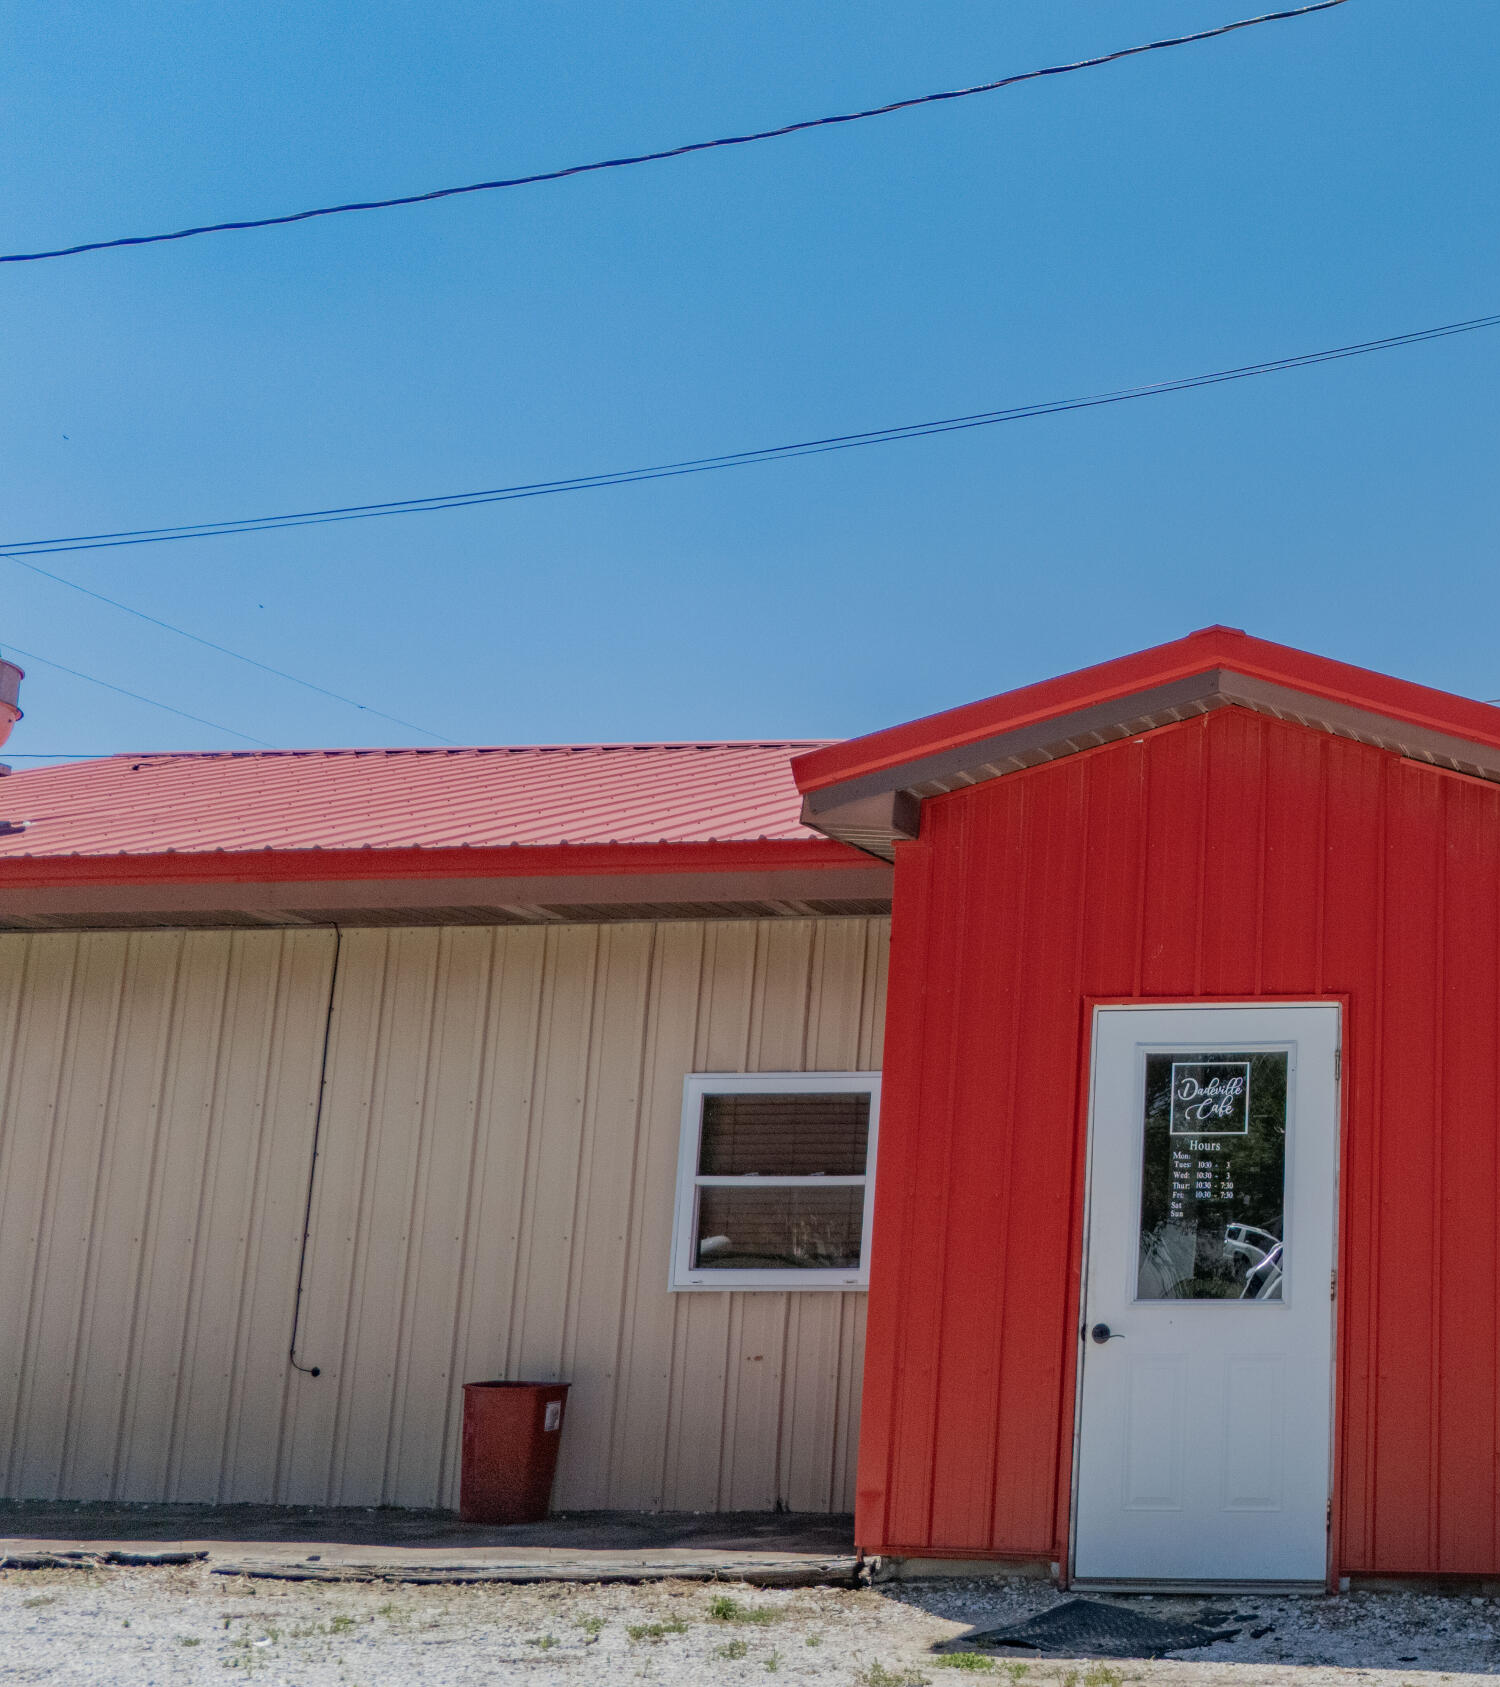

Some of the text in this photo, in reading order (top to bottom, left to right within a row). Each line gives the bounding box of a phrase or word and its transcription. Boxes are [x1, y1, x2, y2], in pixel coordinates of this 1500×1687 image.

[1178, 1077, 1243, 1100] Dadeville
[1185, 1095, 1234, 1119] Cafe
[1190, 1140, 1221, 1151] Hours
[1173, 1152, 1191, 1160] Mon:
[1226, 1161, 1231, 1169] 3
